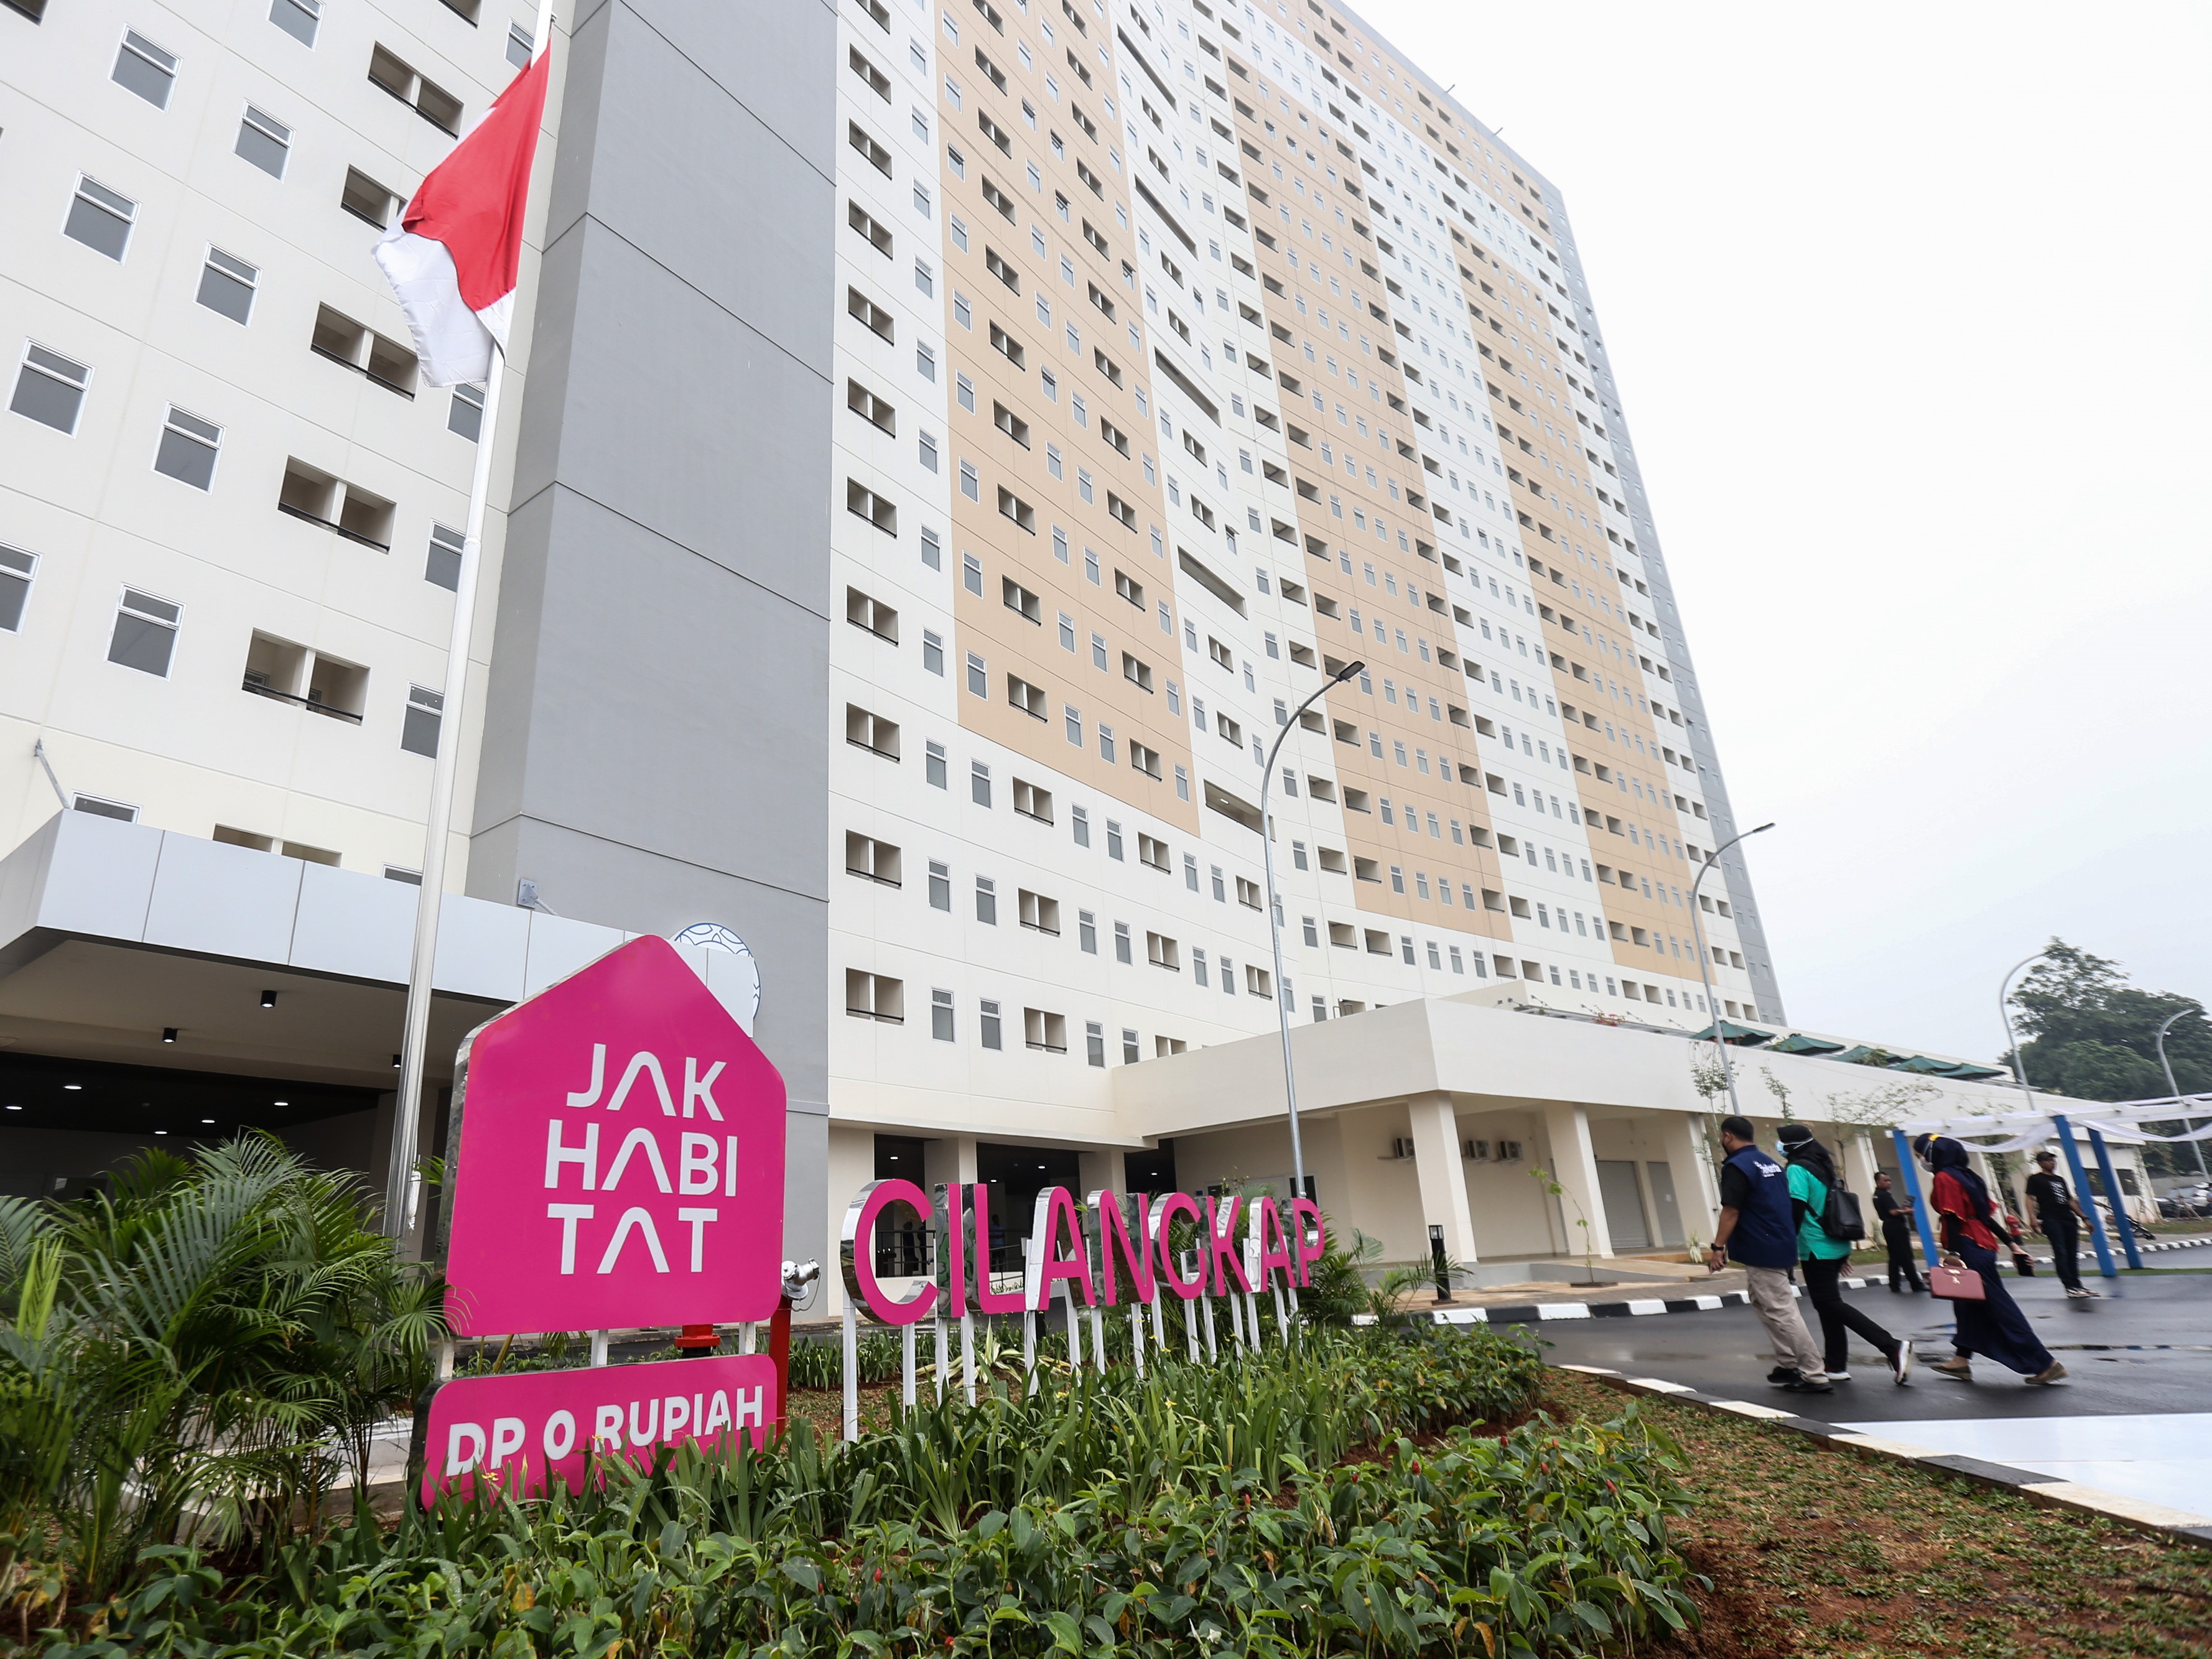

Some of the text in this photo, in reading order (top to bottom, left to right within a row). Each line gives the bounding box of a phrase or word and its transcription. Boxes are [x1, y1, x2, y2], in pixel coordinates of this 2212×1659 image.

[565, 1043, 727, 1122] JAK
[544, 1118, 738, 1197] HABI
[546, 1202, 718, 1275] TAT
[842, 1178, 1325, 1326] CILANGKAP
[446, 1421, 526, 1477] DP
[593, 1385, 763, 1454] RUPIAH
